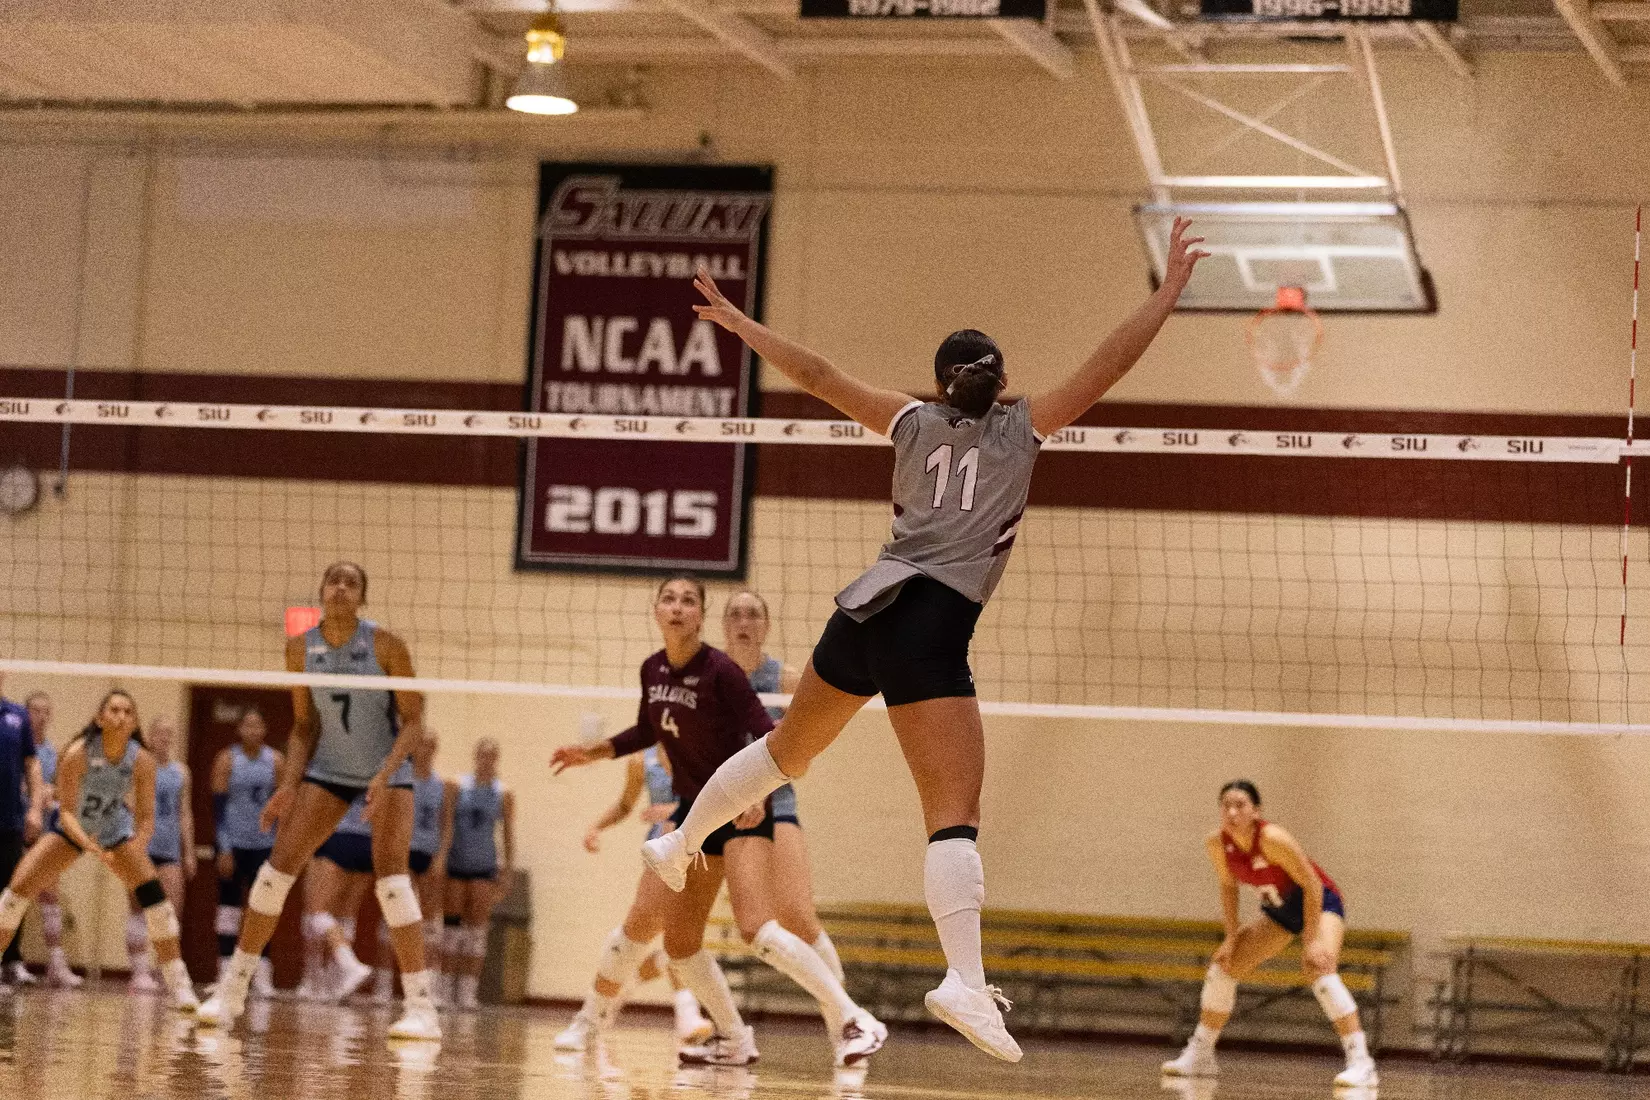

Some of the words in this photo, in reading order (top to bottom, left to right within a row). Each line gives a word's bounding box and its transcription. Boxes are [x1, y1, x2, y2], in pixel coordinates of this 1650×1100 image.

[553, 250, 746, 281] VOLLEYBALL
[561, 315, 721, 377] NCAA
[546, 381, 736, 417] TOURNAMENT
[0, 402, 29, 415] SIU
[98, 404, 129, 418] SIU
[200, 407, 230, 421] SIU
[301, 410, 333, 424] SIU
[403, 413, 436, 427] SIU
[508, 416, 541, 430] SIU
[614, 419, 648, 433] SIU
[721, 422, 755, 436] SIU
[830, 424, 864, 438] SIU
[1051, 430, 1085, 444] SIU
[1163, 432, 1198, 446] SIU
[1276, 435, 1312, 449] SIU
[1391, 437, 1427, 451] SIU
[1507, 439, 1543, 453] SIU
[925, 443, 979, 511] 11
[545, 484, 718, 539] 2015
[330, 693, 350, 734] 7
[648, 684, 698, 709] SALUKIS
[661, 707, 680, 738] 4
